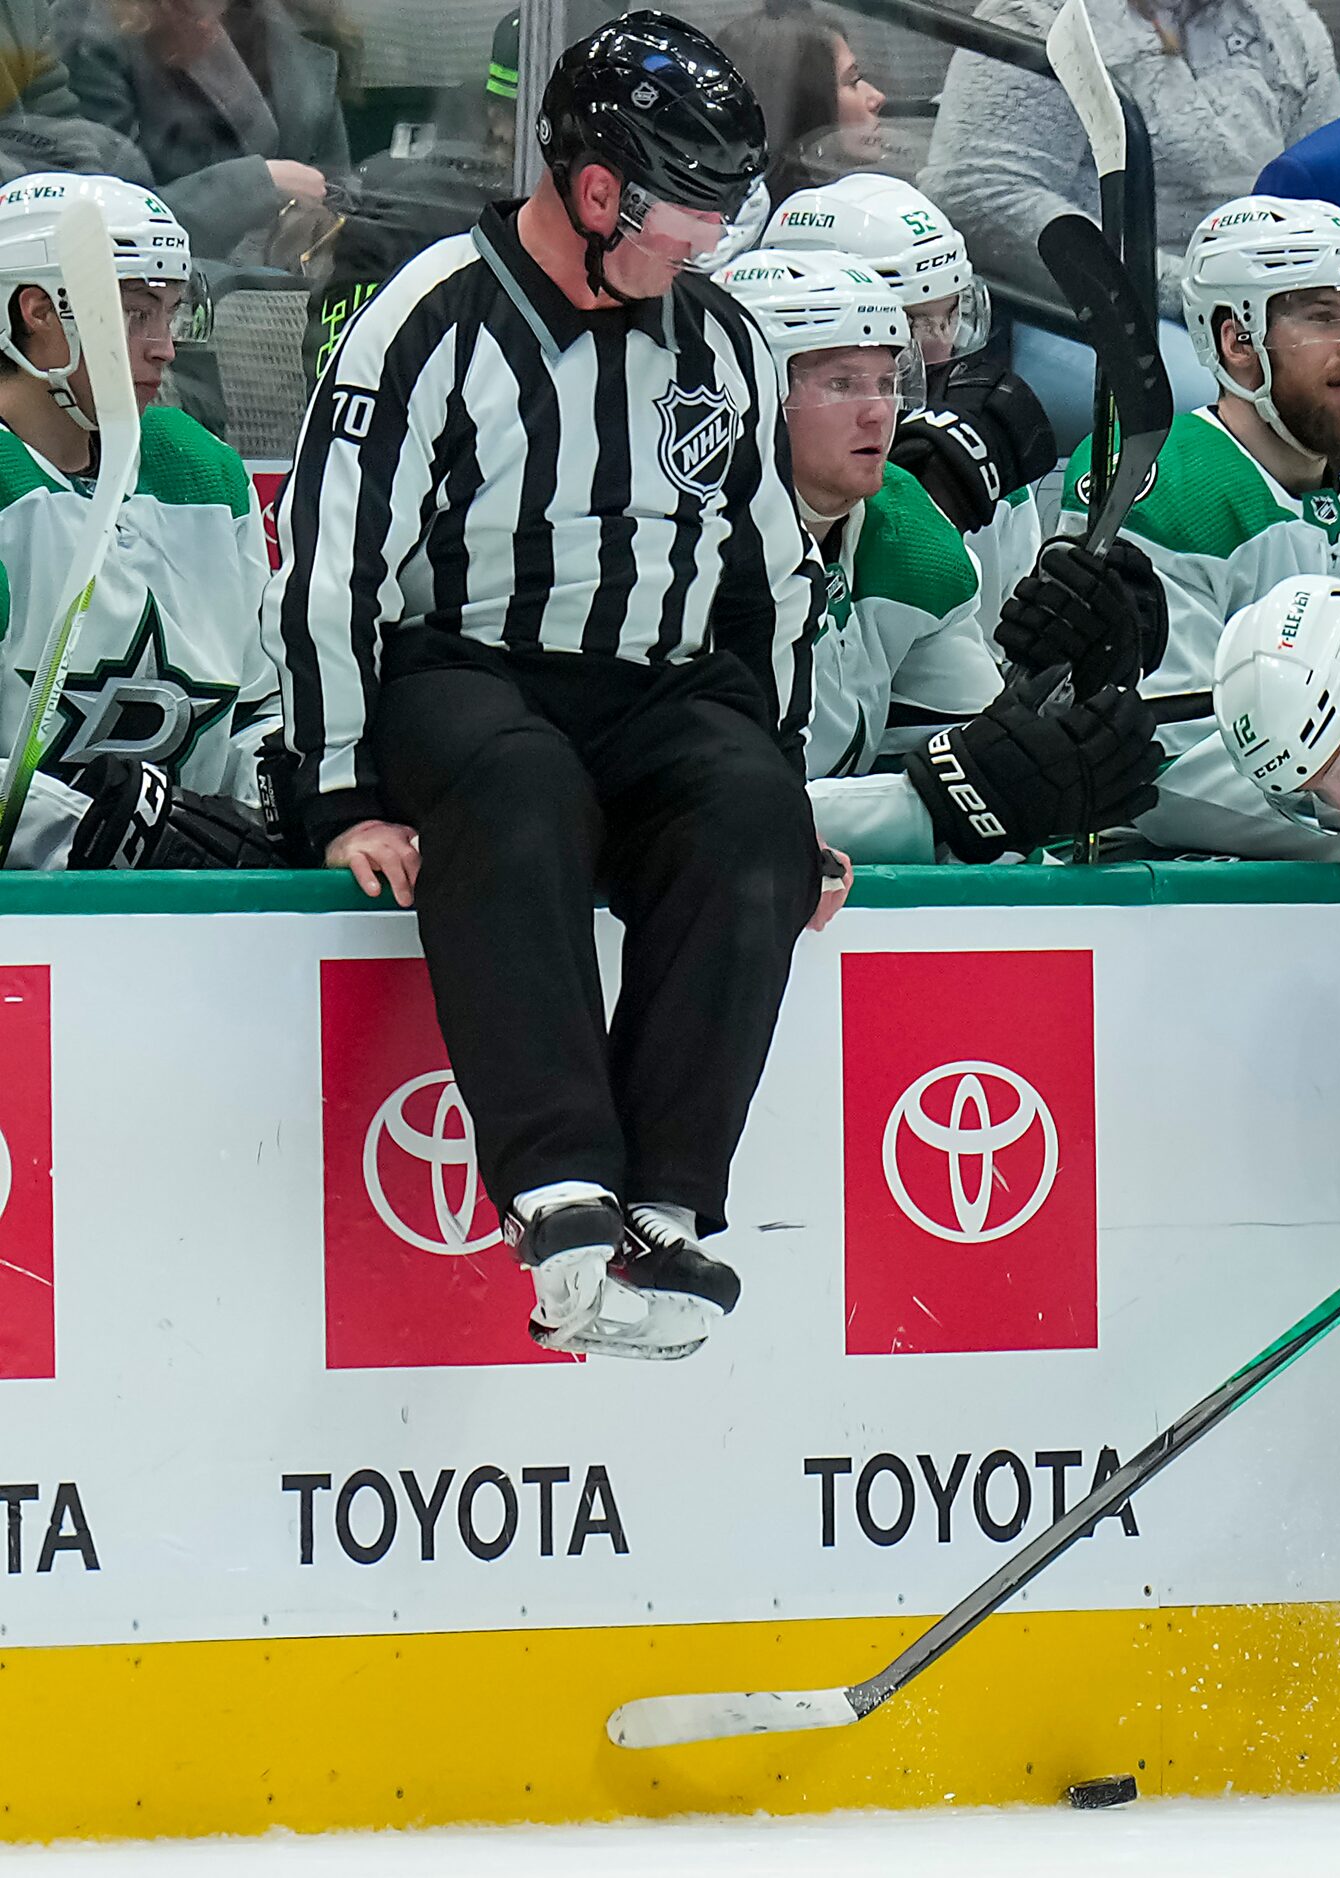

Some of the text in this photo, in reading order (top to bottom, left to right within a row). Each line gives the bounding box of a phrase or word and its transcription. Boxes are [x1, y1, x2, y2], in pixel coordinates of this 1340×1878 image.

[151, 236, 186, 248] CCM
[915, 250, 958, 274] CCM
[681, 416, 728, 473] NHL
[1253, 748, 1291, 780] CCM
[281, 1465, 630, 1566] TOYOTA
[803, 1447, 1140, 1548] TOYOTA
